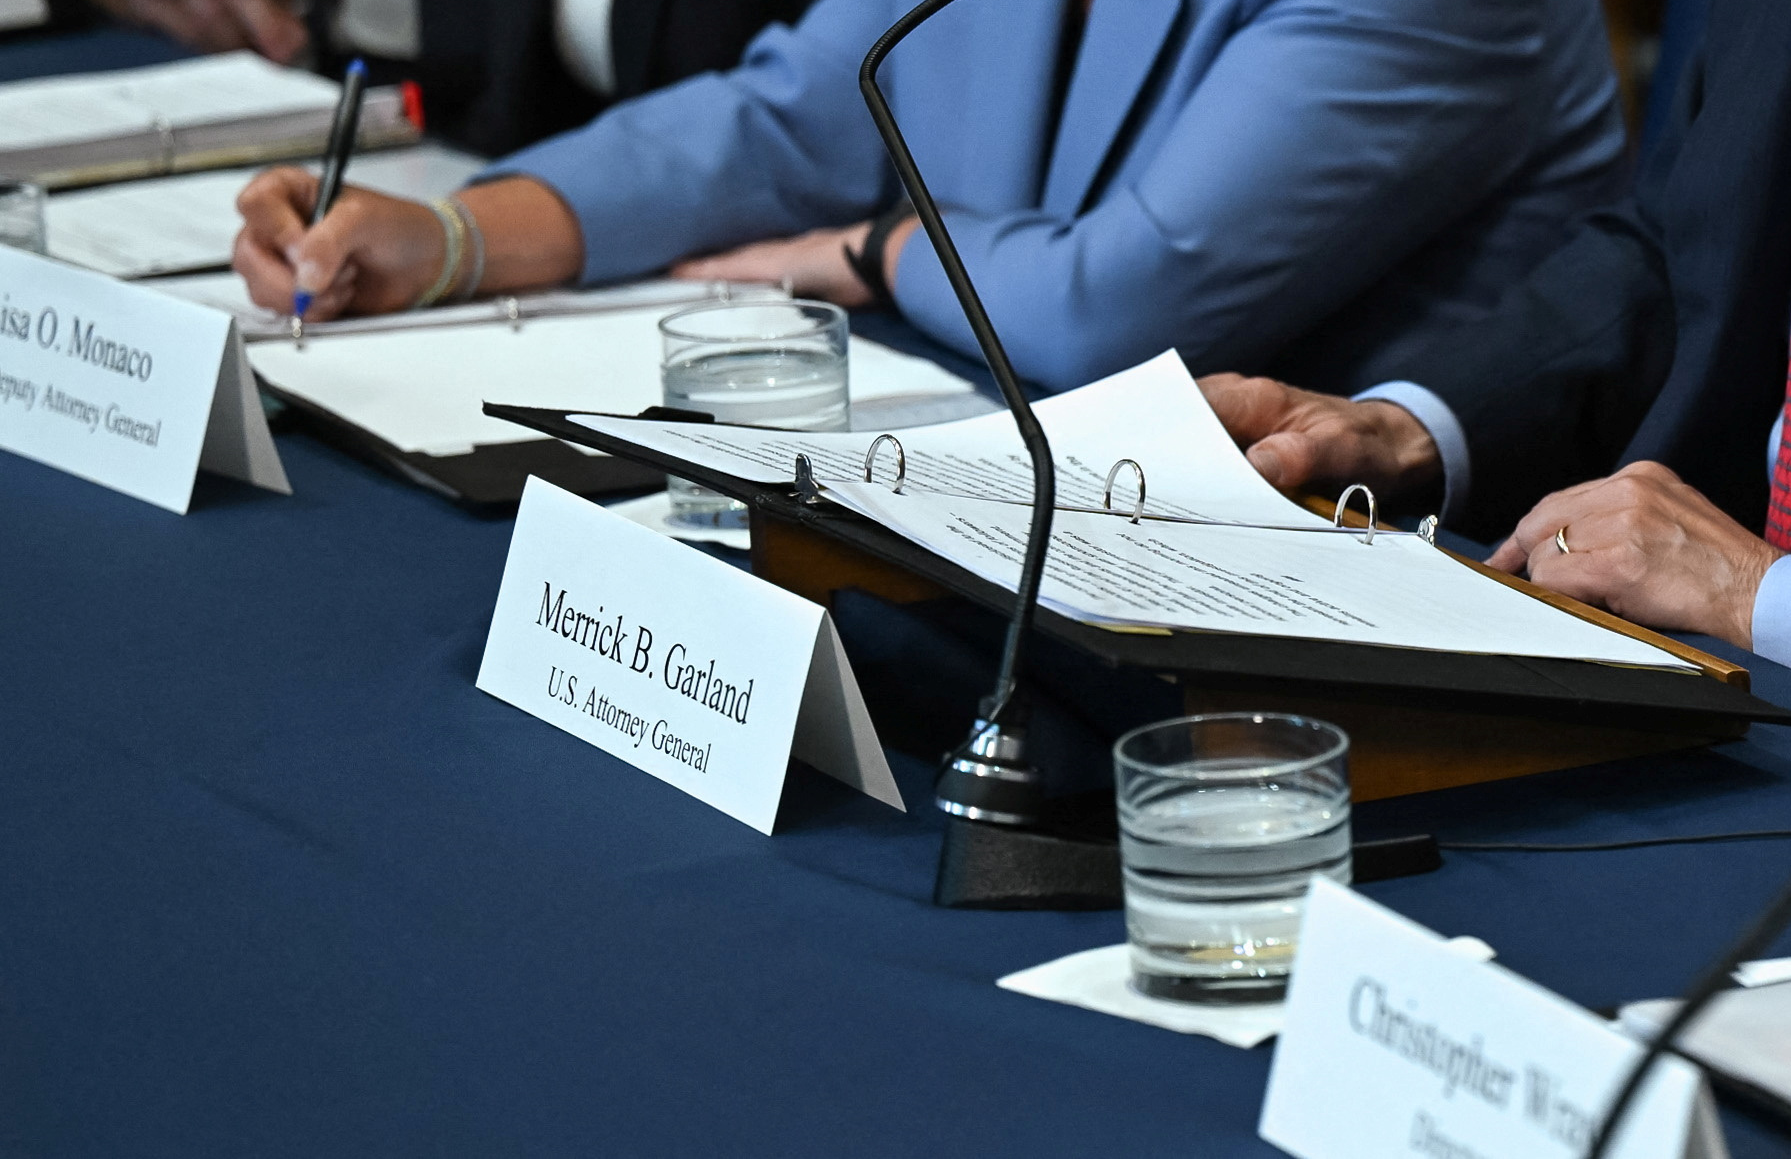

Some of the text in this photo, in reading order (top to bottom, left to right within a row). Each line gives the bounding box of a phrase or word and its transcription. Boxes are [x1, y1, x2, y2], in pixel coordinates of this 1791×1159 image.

[0, 293, 154, 383] isa O. Monaco
[0, 371, 162, 448] eputy Attorney General
[536, 582, 754, 725] Merrick B. Garland
[547, 666, 712, 773] U.S. Attorney General
[1348, 974, 1516, 1109] Christopher
[1522, 1062, 1594, 1151] Wra
